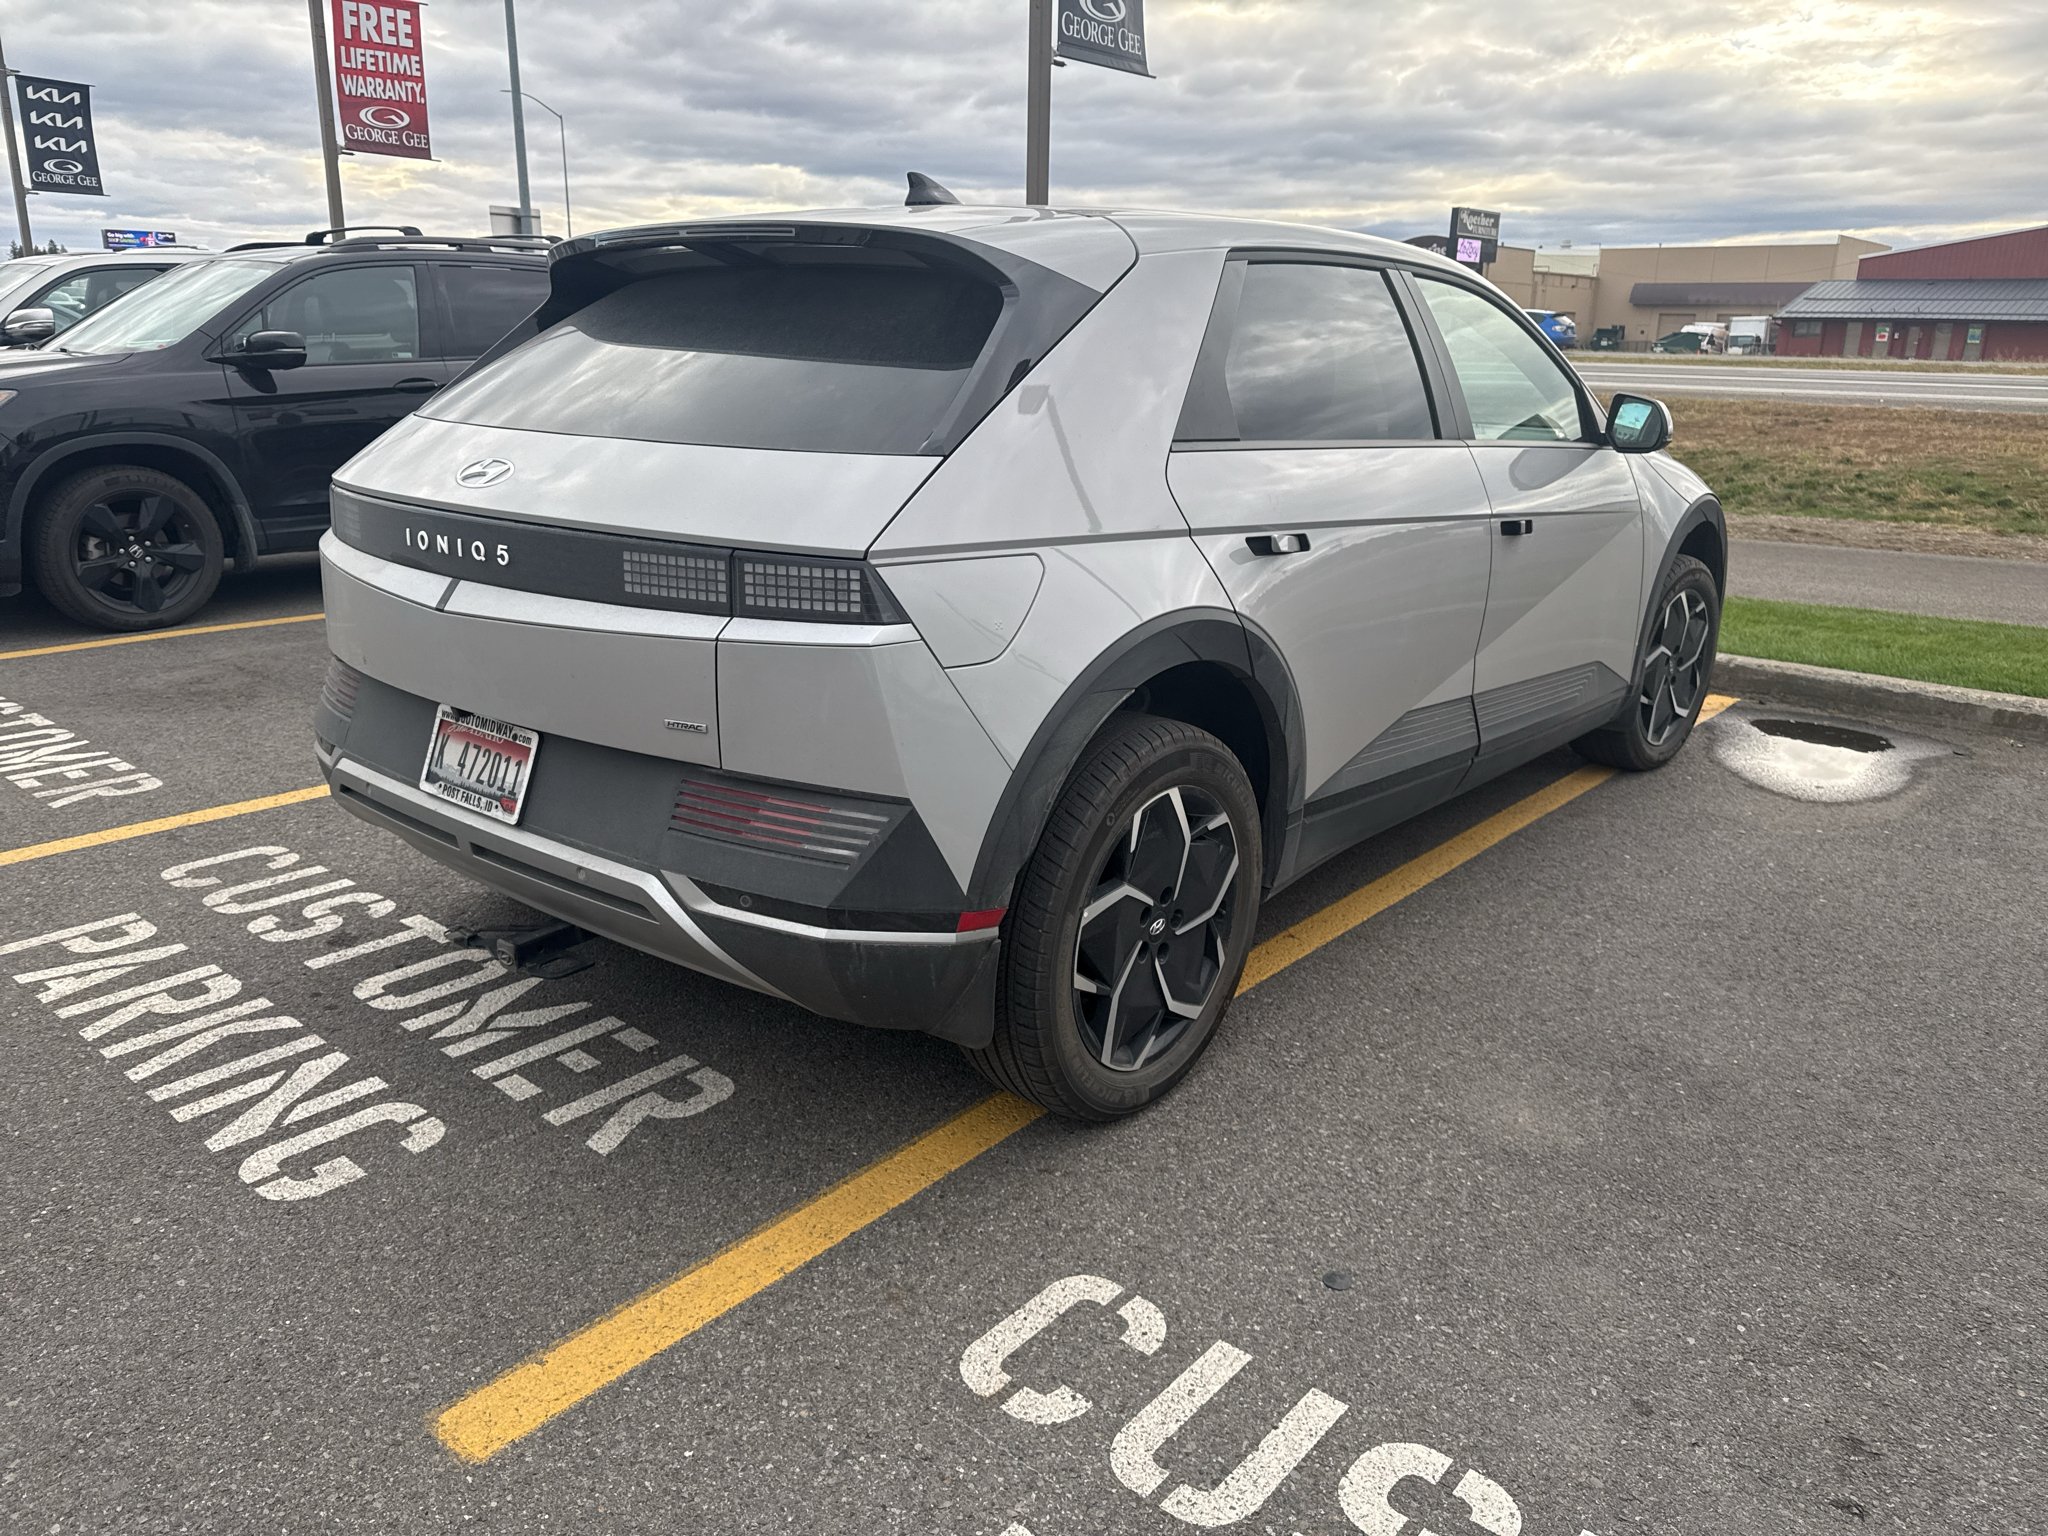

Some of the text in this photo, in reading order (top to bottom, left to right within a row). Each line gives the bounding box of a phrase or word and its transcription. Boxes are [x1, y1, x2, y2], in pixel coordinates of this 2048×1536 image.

[341, 0, 414, 48] FREE
[1061, 11, 1143, 55] GEORGE GEE
[340, 45, 421, 77] LIFETIME
[26, 85, 81, 105] KIA
[340, 73, 425, 104] WARRANTY.
[29, 110, 83, 130] KIA
[345, 123, 428, 148] GEORGE GEE
[34, 134, 88, 154] KIA
[32, 171, 99, 187] GEORGE GEE
[406, 527, 510, 567] IONIQ 5
[667, 720, 704, 732] HTRAC
[434, 733, 523, 797] K 472011
[442, 784, 494, 813] POST FALLS, ID
[160, 845, 736, 1157] CUSTOMER
[0, 912, 446, 1201] PARKING
